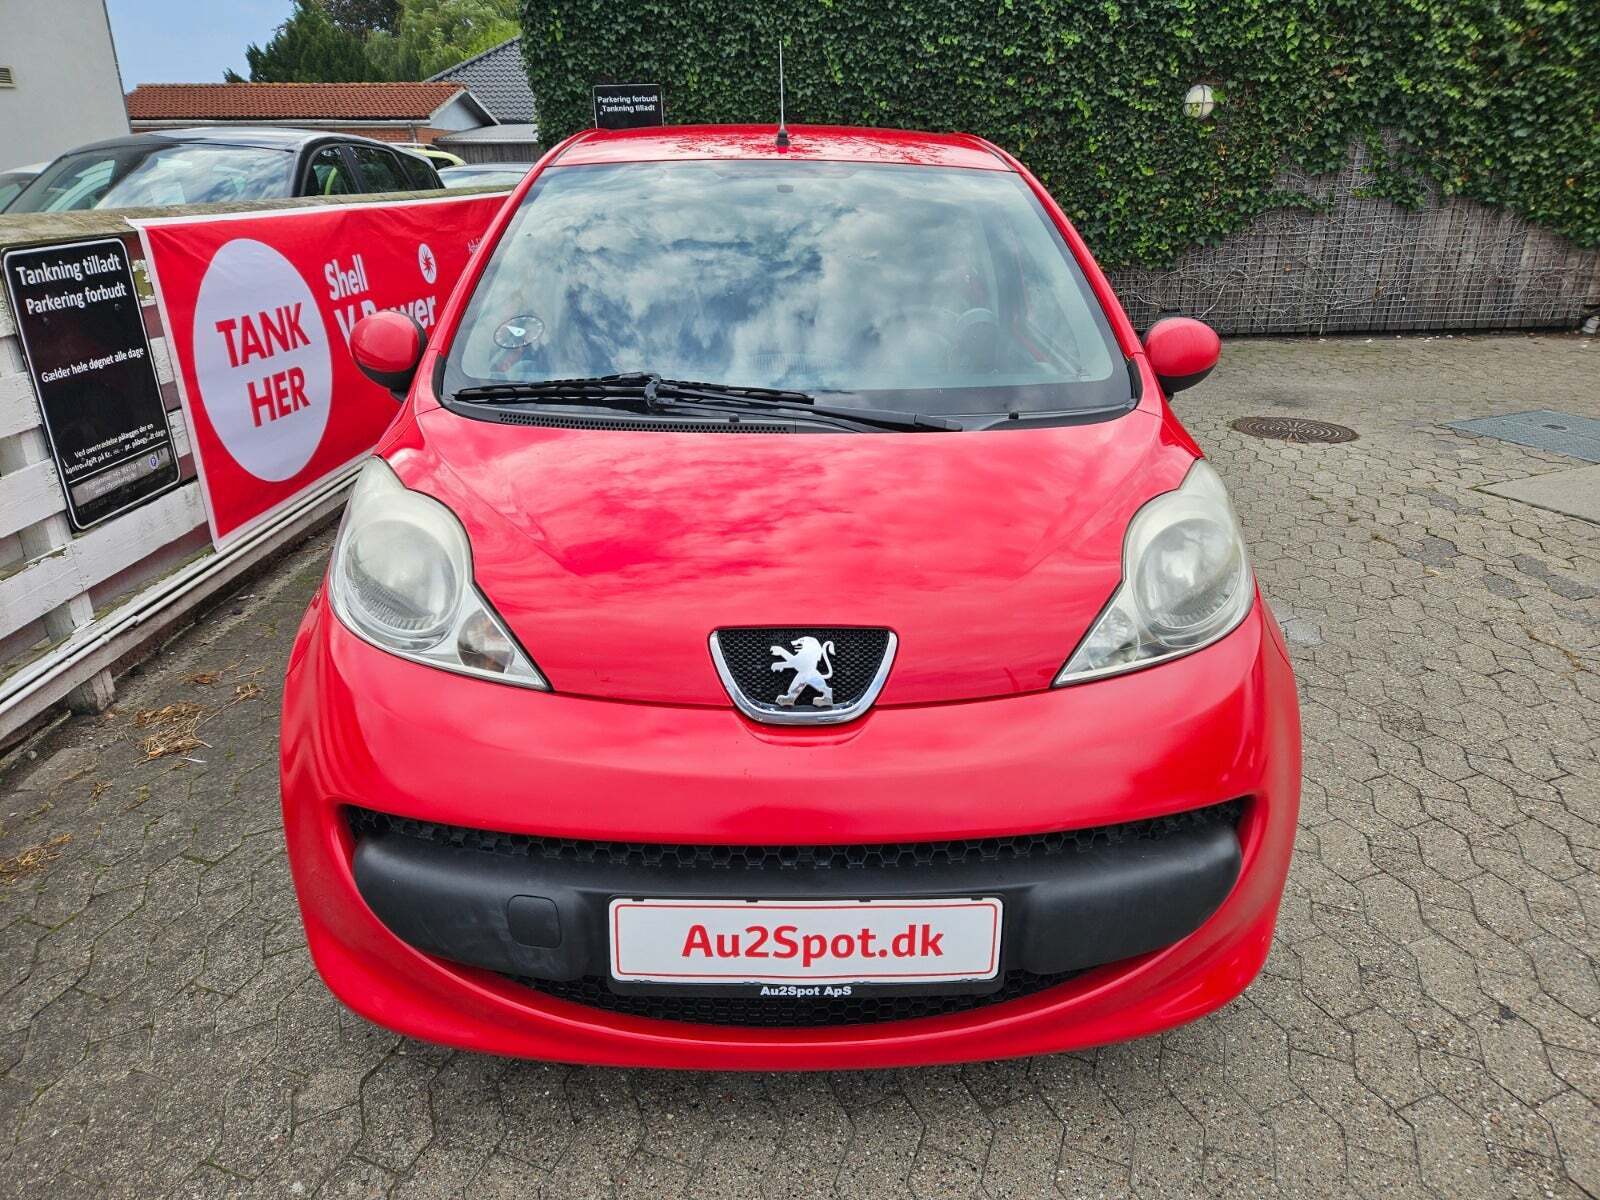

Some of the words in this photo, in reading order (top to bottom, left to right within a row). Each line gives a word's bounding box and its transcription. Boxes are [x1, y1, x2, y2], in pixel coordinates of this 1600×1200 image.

[597, 95, 631, 104] Parkering
[632, 95, 657, 103] forbudt
[602, 104, 634, 113] Tankning
[635, 104, 656, 112] tilladt
[16, 260, 83, 286] Tankning
[83, 253, 122, 276] tilladt
[324, 254, 369, 301] Shell
[26, 291, 84, 316] Parkering
[85, 282, 127, 305] forbudt
[215, 302, 311, 368] TANK
[42, 367, 70, 383] Gælder
[71, 362, 88, 374] hele
[89, 356, 114, 371] døgnet
[115, 350, 127, 362] alle
[128, 347, 145, 359] dage
[247, 367, 311, 428] HER
[682, 923, 944, 968] Au2Spot.dk
[760, 986, 820, 998] Au2Spot
[823, 986, 852, 998] ApS
